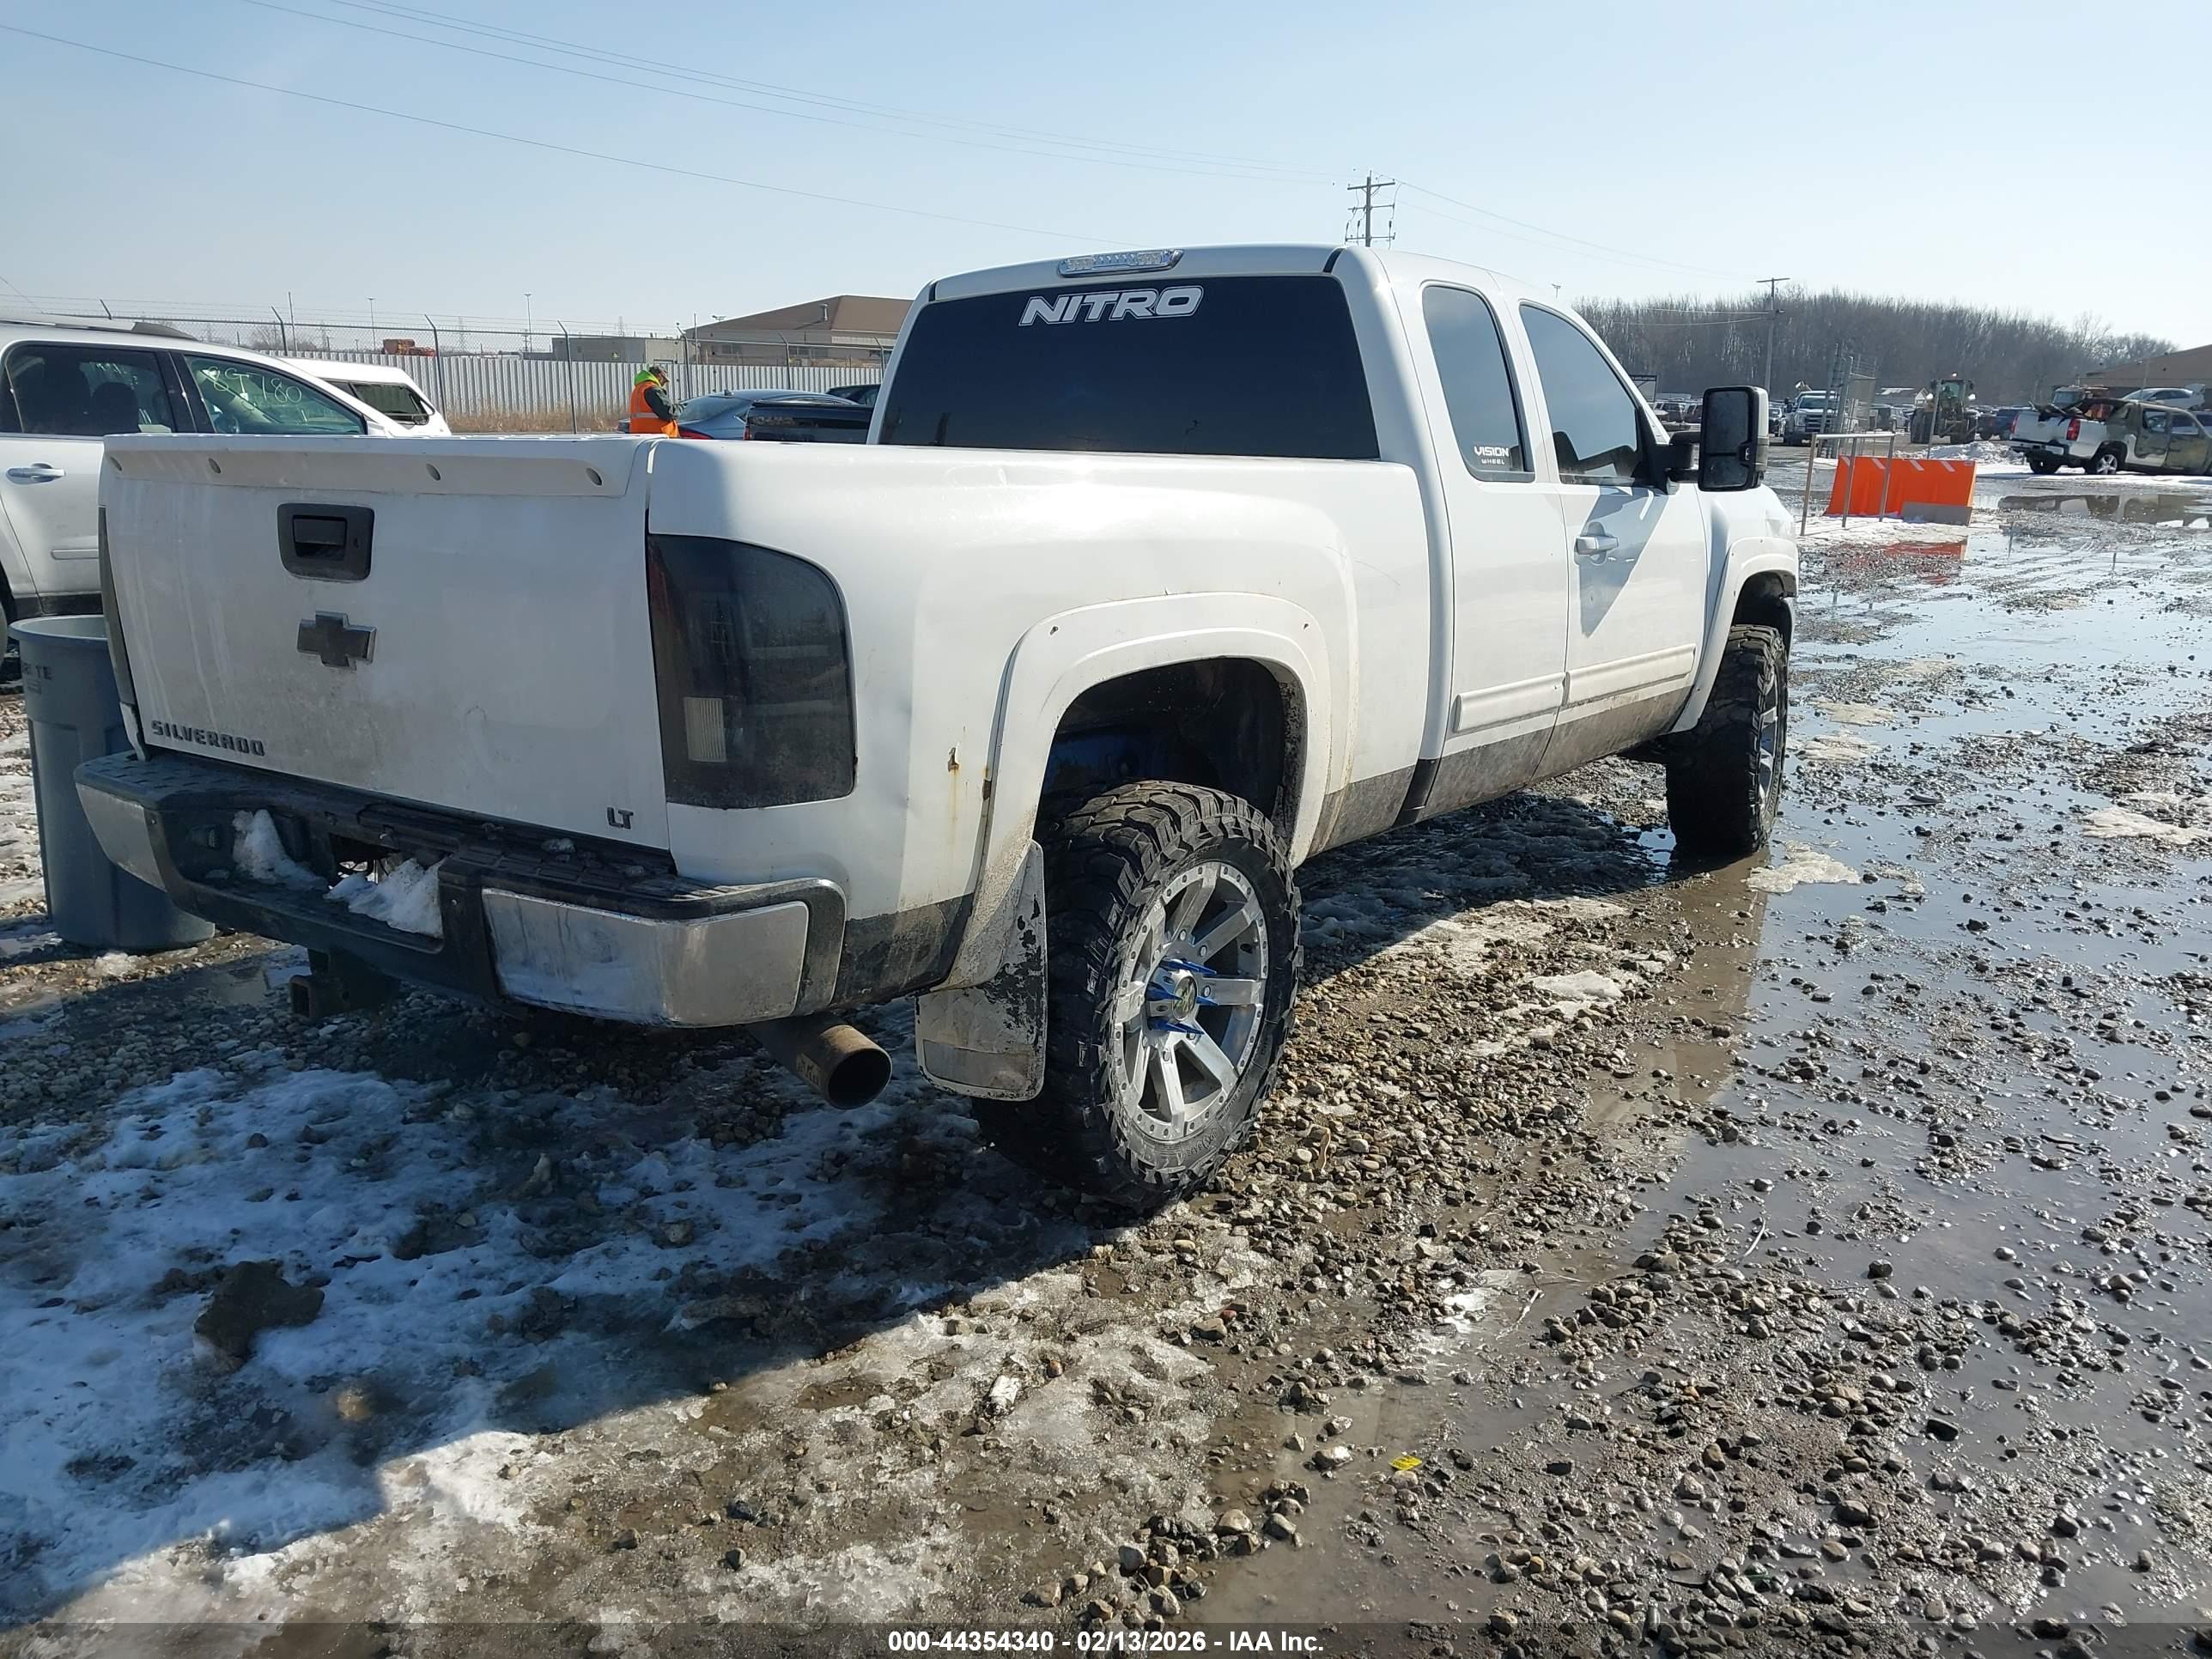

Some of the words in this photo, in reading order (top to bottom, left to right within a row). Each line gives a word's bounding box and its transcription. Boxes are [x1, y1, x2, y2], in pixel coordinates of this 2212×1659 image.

[1018, 285, 1204, 326] NITRO
[1474, 446, 1510, 457] VISION
[151, 720, 265, 757] SILVERADO
[606, 806, 634, 830] LT
